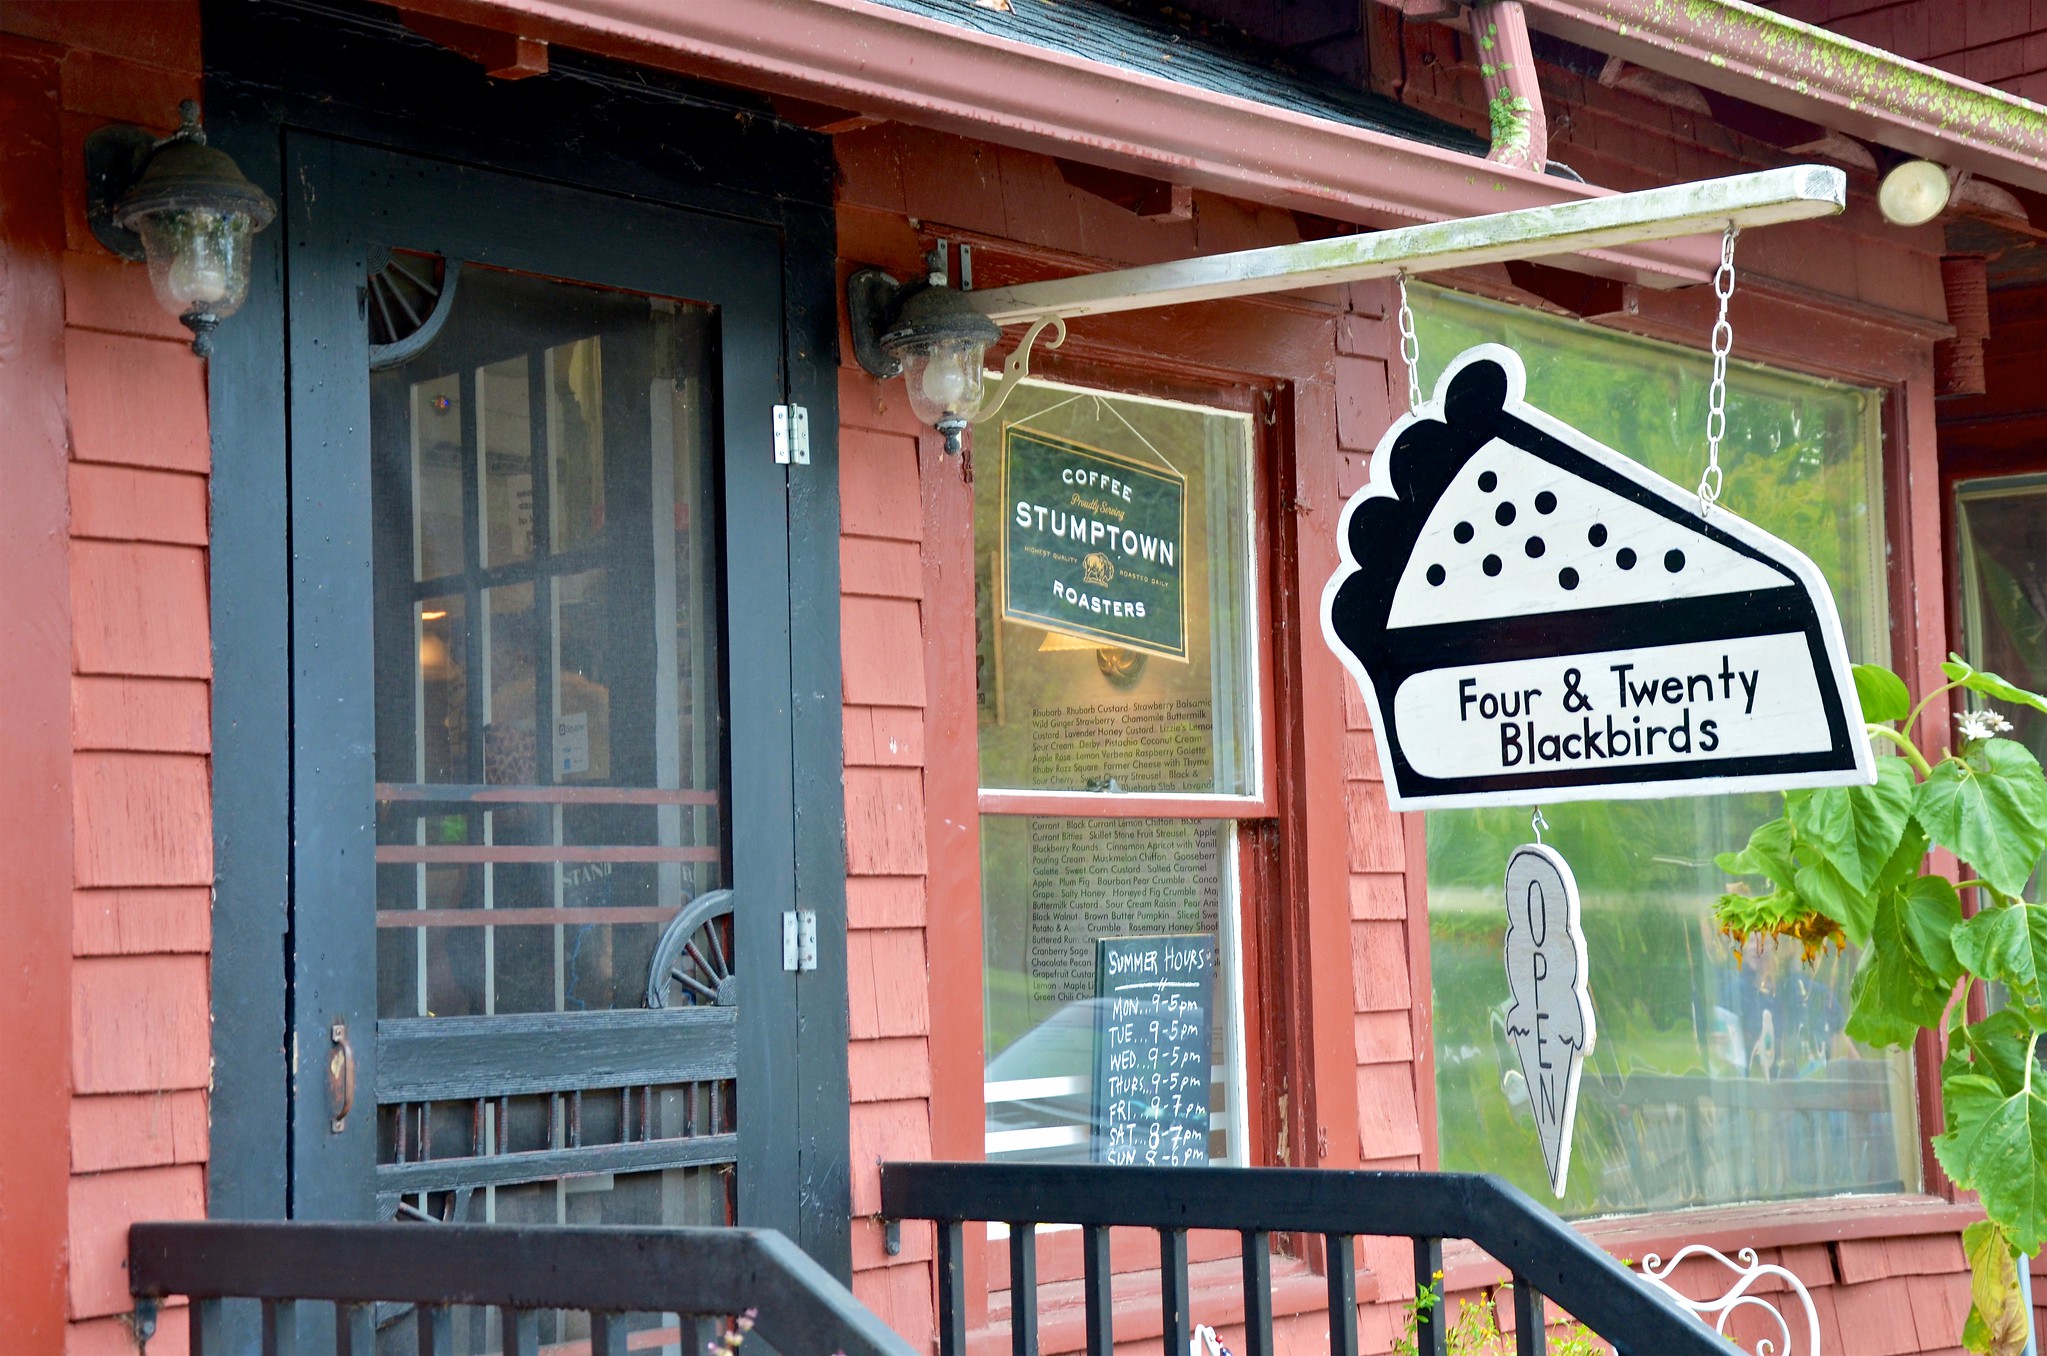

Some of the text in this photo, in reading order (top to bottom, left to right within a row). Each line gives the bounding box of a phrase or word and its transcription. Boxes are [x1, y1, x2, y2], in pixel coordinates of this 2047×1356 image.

[1062, 468, 1133, 503] COFFEE
[1071, 493, 1125, 521] Proudly Serving
[1015, 501, 1174, 567] STUMPTOWN
[1052, 552, 1078, 564] QUALITY
[1119, 569, 1169, 588] ROASTED DAILY
[1052, 579, 1146, 618] ROASTERS
[1458, 654, 1759, 722] Four & Twenty
[1032, 699, 1212, 717] Rhubarb Rhubarb Custard Strawberry Balsamic
[1032, 710, 1206, 731] Wild Ginger Strawberry Chamomile Buttermilk
[1032, 730, 1059, 740] Custard
[1065, 729, 1095, 738] Lavender
[1098, 727, 1123, 737] Honey
[1125, 724, 1154, 735] Custard
[1159, 723, 1186, 733] Lizzie's
[1500, 707, 1719, 767] Blackbirds
[1032, 735, 1201, 751] Sour Cream Derby Pistachio Coconut Cream
[1032, 746, 1206, 763] Apple Rose Lemon Verbena Raspberry Galette
[1032, 758, 1209, 775] Rhuby Razz Square Farmer Cheese with Thyme
[1032, 776, 1048, 785] Sour
[1050, 775, 1074, 786] Cherry
[1131, 772, 1161, 780] Streusel
[1168, 770, 1190, 778] Black
[1192, 769, 1199, 778] &
[1032, 822, 1059, 830] Currant
[1066, 820, 1085, 829] Black
[1088, 819, 1116, 829] Currant
[1118, 819, 1142, 828] Lemon
[1032, 833, 1059, 842] Currant
[1089, 831, 1112, 840] Skillet
[1114, 830, 1134, 839] Stone
[1137, 830, 1153, 838] Fruit
[1156, 828, 1186, 837] Streusel
[1193, 827, 1216, 837] Apple
[1032, 838, 1217, 854] Blackberry Rounds Cinnamon Apricot with Vanill
[1032, 851, 1216, 865] Pouring Cream Muskmelon Chiffon Gooseberr
[1033, 863, 1207, 875] Galette Sweet Corn Custard Salted Caramel
[1032, 874, 1218, 888] Apple Plum Fig Bourbon Pear Crumble Conco
[1032, 890, 1055, 899] Grape
[1061, 889, 1078, 899] Salty
[1081, 889, 1105, 899] Honey
[1112, 888, 1147, 898] Honeyed
[1150, 887, 1160, 898] Fig
[1163, 886, 1196, 896] Crumble
[1032, 900, 1068, 910] Buttermilk
[1070, 900, 1098, 909] Custard
[1105, 900, 1123, 908] Sour
[1127, 899, 1152, 908] Cream
[1154, 898, 1176, 907] Raisin
[1184, 898, 1200, 907] Pear
[1032, 912, 1050, 921] Black
[1053, 912, 1078, 921] Walnut
[1084, 912, 1109, 920] Brown
[1111, 911, 1134, 920] Butter
[1137, 911, 1169, 920] Pumpkin
[1177, 910, 1200, 919] Sliced
[1032, 924, 1054, 932] Potato
[1056, 923, 1061, 932] &
[1087, 922, 1121, 932] Crumble
[1129, 922, 1165, 932] Rosemary
[1168, 921, 1193, 932] Honey
[1196, 921, 1218, 931] Shoof
[1033, 935, 1061, 943] Buttered
[1032, 946, 1088, 958] Cranberry Sage
[1032, 958, 1091, 967] Chocolate Pecan
[1109, 950, 1157, 975] SUMMER
[1033, 969, 1095, 979] Grapefruit Custar
[1033, 981, 1056, 989] Lemon
[1064, 981, 1085, 991] Maple
[1527, 879, 1557, 1126] OPEN
[1108, 1149, 1136, 1166] SUN
